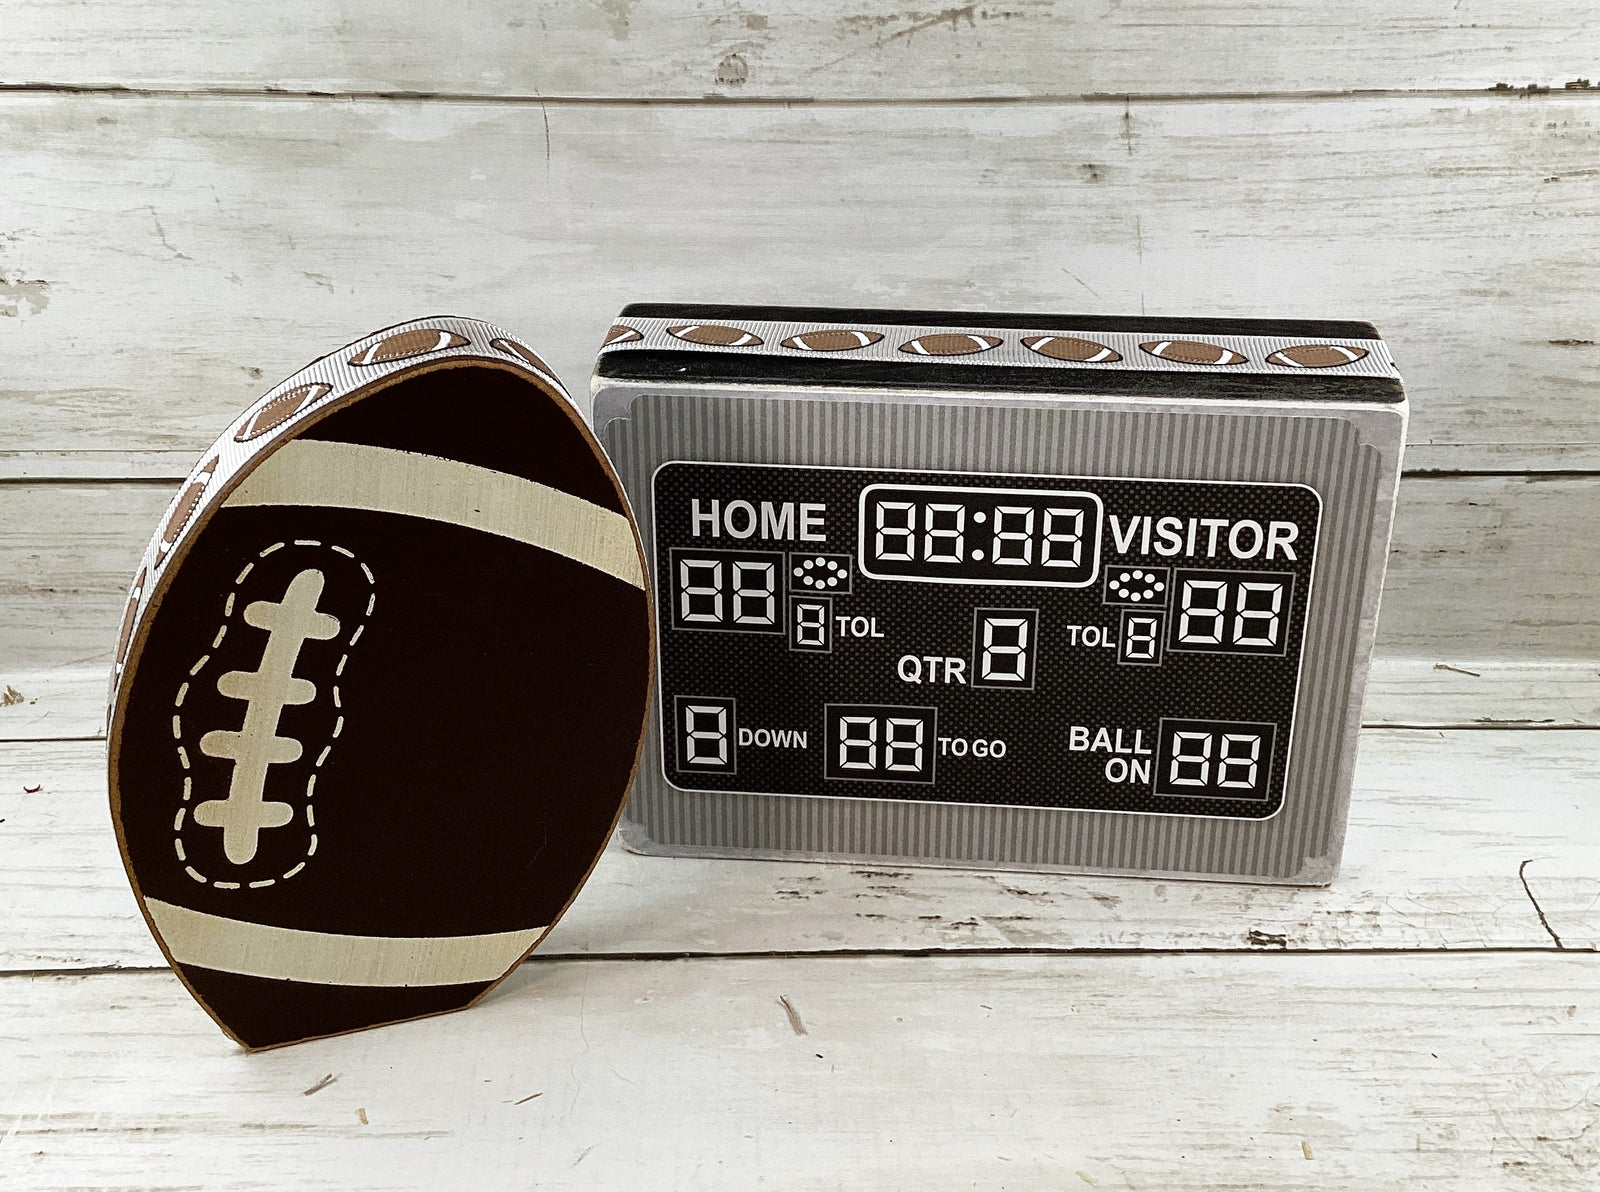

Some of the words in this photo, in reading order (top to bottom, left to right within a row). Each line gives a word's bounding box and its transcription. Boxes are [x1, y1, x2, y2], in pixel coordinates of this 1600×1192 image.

[692, 499, 826, 541] HOME
[1109, 515, 1298, 560] VISITOR
[681, 560, 774, 624] 88
[1179, 580, 1283, 646] 88
[797, 604, 824, 645] 8
[836, 616, 884, 637] TOL
[898, 655, 966, 684] QTR
[982, 618, 1028, 681] 8
[1067, 625, 1115, 647] TOL
[1126, 618, 1157, 658] 8
[686, 706, 727, 764] 8
[739, 728, 806, 748] DOWN
[840, 717, 923, 772] 88
[938, 738, 968, 756] TO
[973, 739, 1006, 758] GO
[1069, 726, 1151, 754] BALL
[1105, 758, 1150, 784] ON
[1170, 732, 1260, 788] 88
